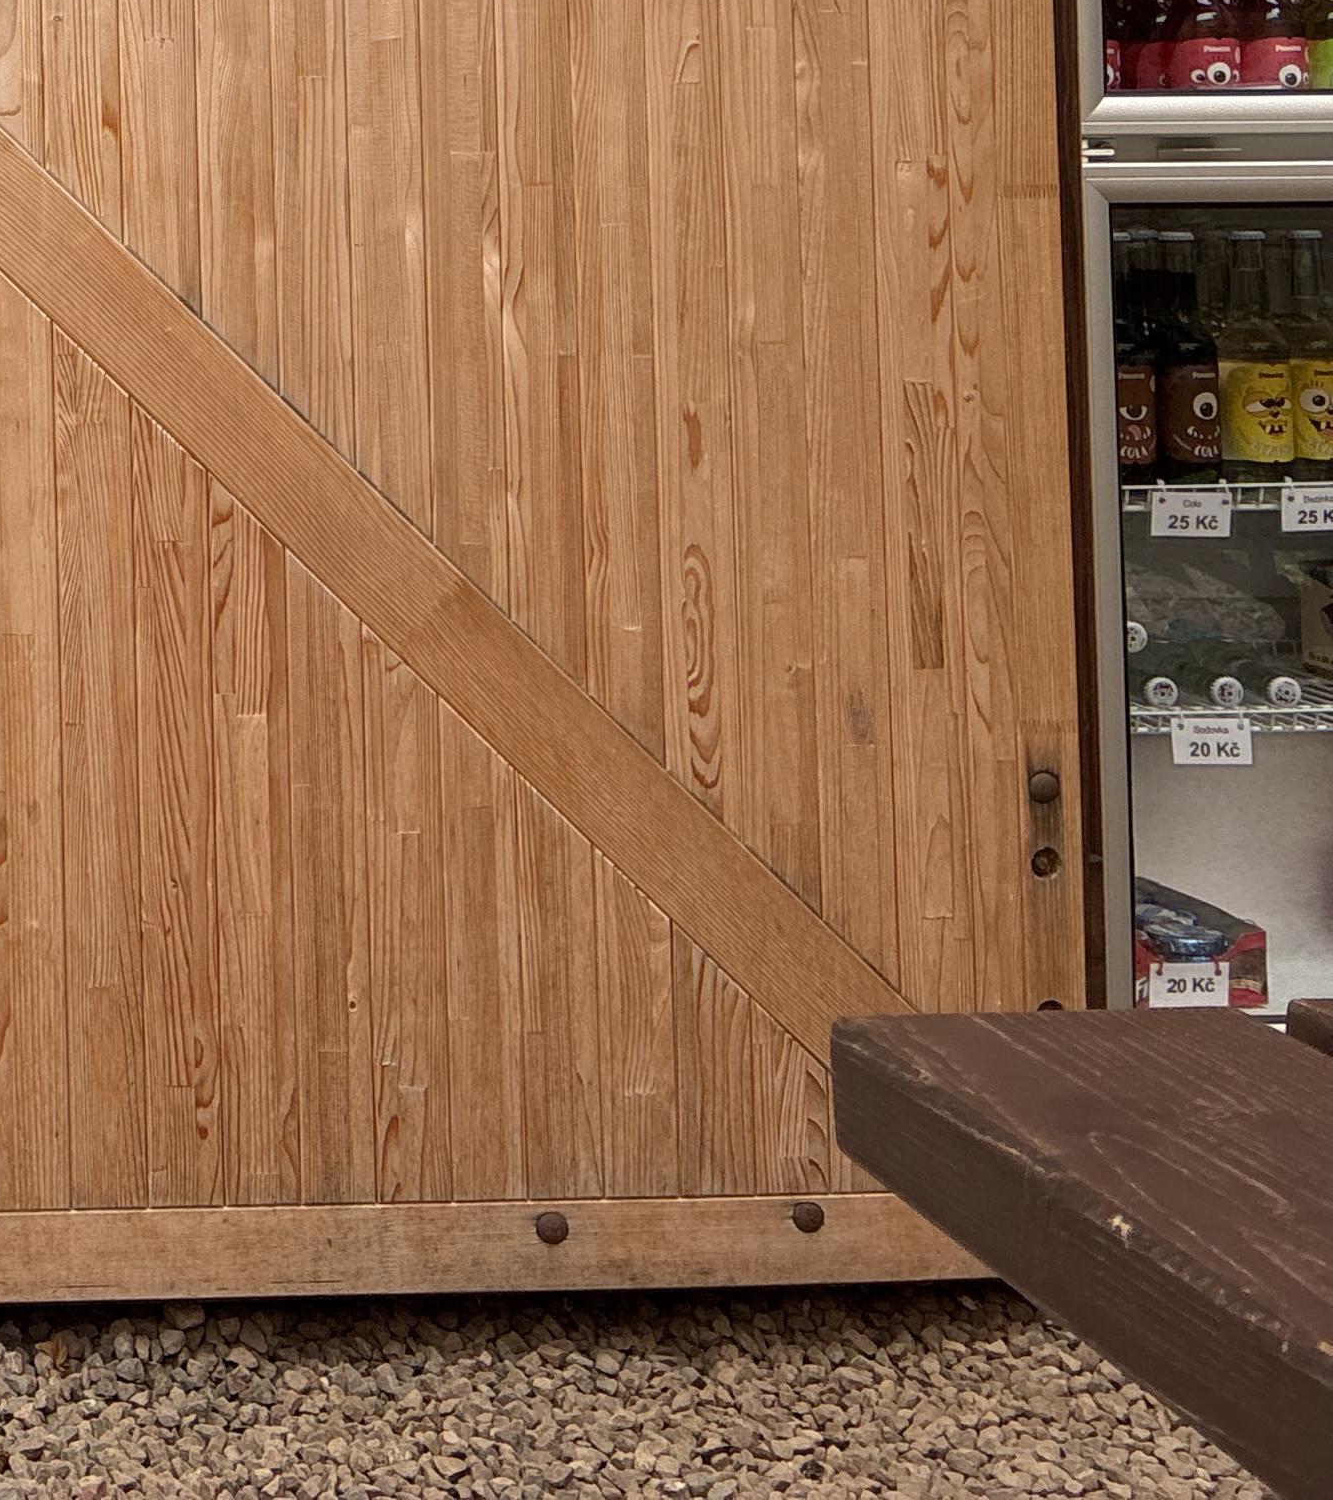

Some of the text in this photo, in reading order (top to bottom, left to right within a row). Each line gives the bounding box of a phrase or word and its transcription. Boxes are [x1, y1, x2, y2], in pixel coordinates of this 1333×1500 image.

[1168, 514, 1219, 530] 25 Kč
[1297, 509, 1333, 525] 25 K
[1189, 741, 1240, 757] 20 Kč
[1167, 977, 1215, 993] 20 Kč
